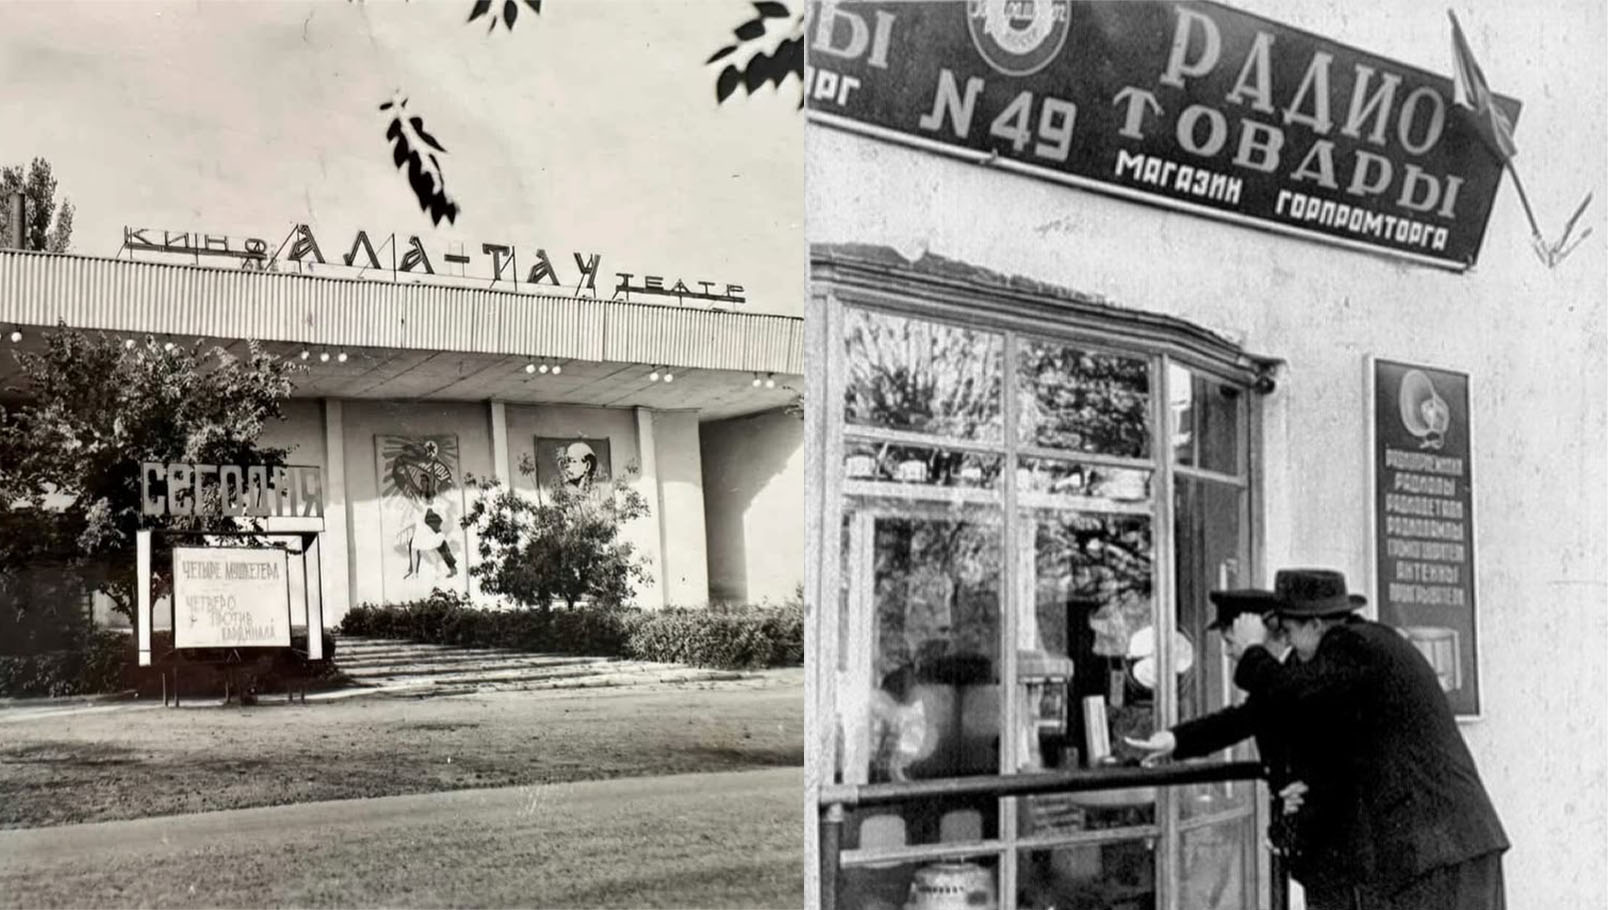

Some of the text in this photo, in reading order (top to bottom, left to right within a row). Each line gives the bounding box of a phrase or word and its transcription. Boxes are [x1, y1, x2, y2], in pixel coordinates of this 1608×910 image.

[804, 0, 896, 69] Ы
[1159, 5, 1445, 154] РАДИО
[990, 90, 1077, 162] 49
[1113, 86, 1463, 218] ТОВАРЫ
[1115, 149, 1449, 250] МАГАЗИН ГОРПРОМТОРГА
[124, 225, 745, 300] КИНО АЛА-ТАУ ТЕАТР
[142, 462, 323, 517] СЕГОДНЯ
[182, 560, 222, 580] ЧЕТЫРЕ
[186, 594, 236, 613] ЧЕТВЕРО
